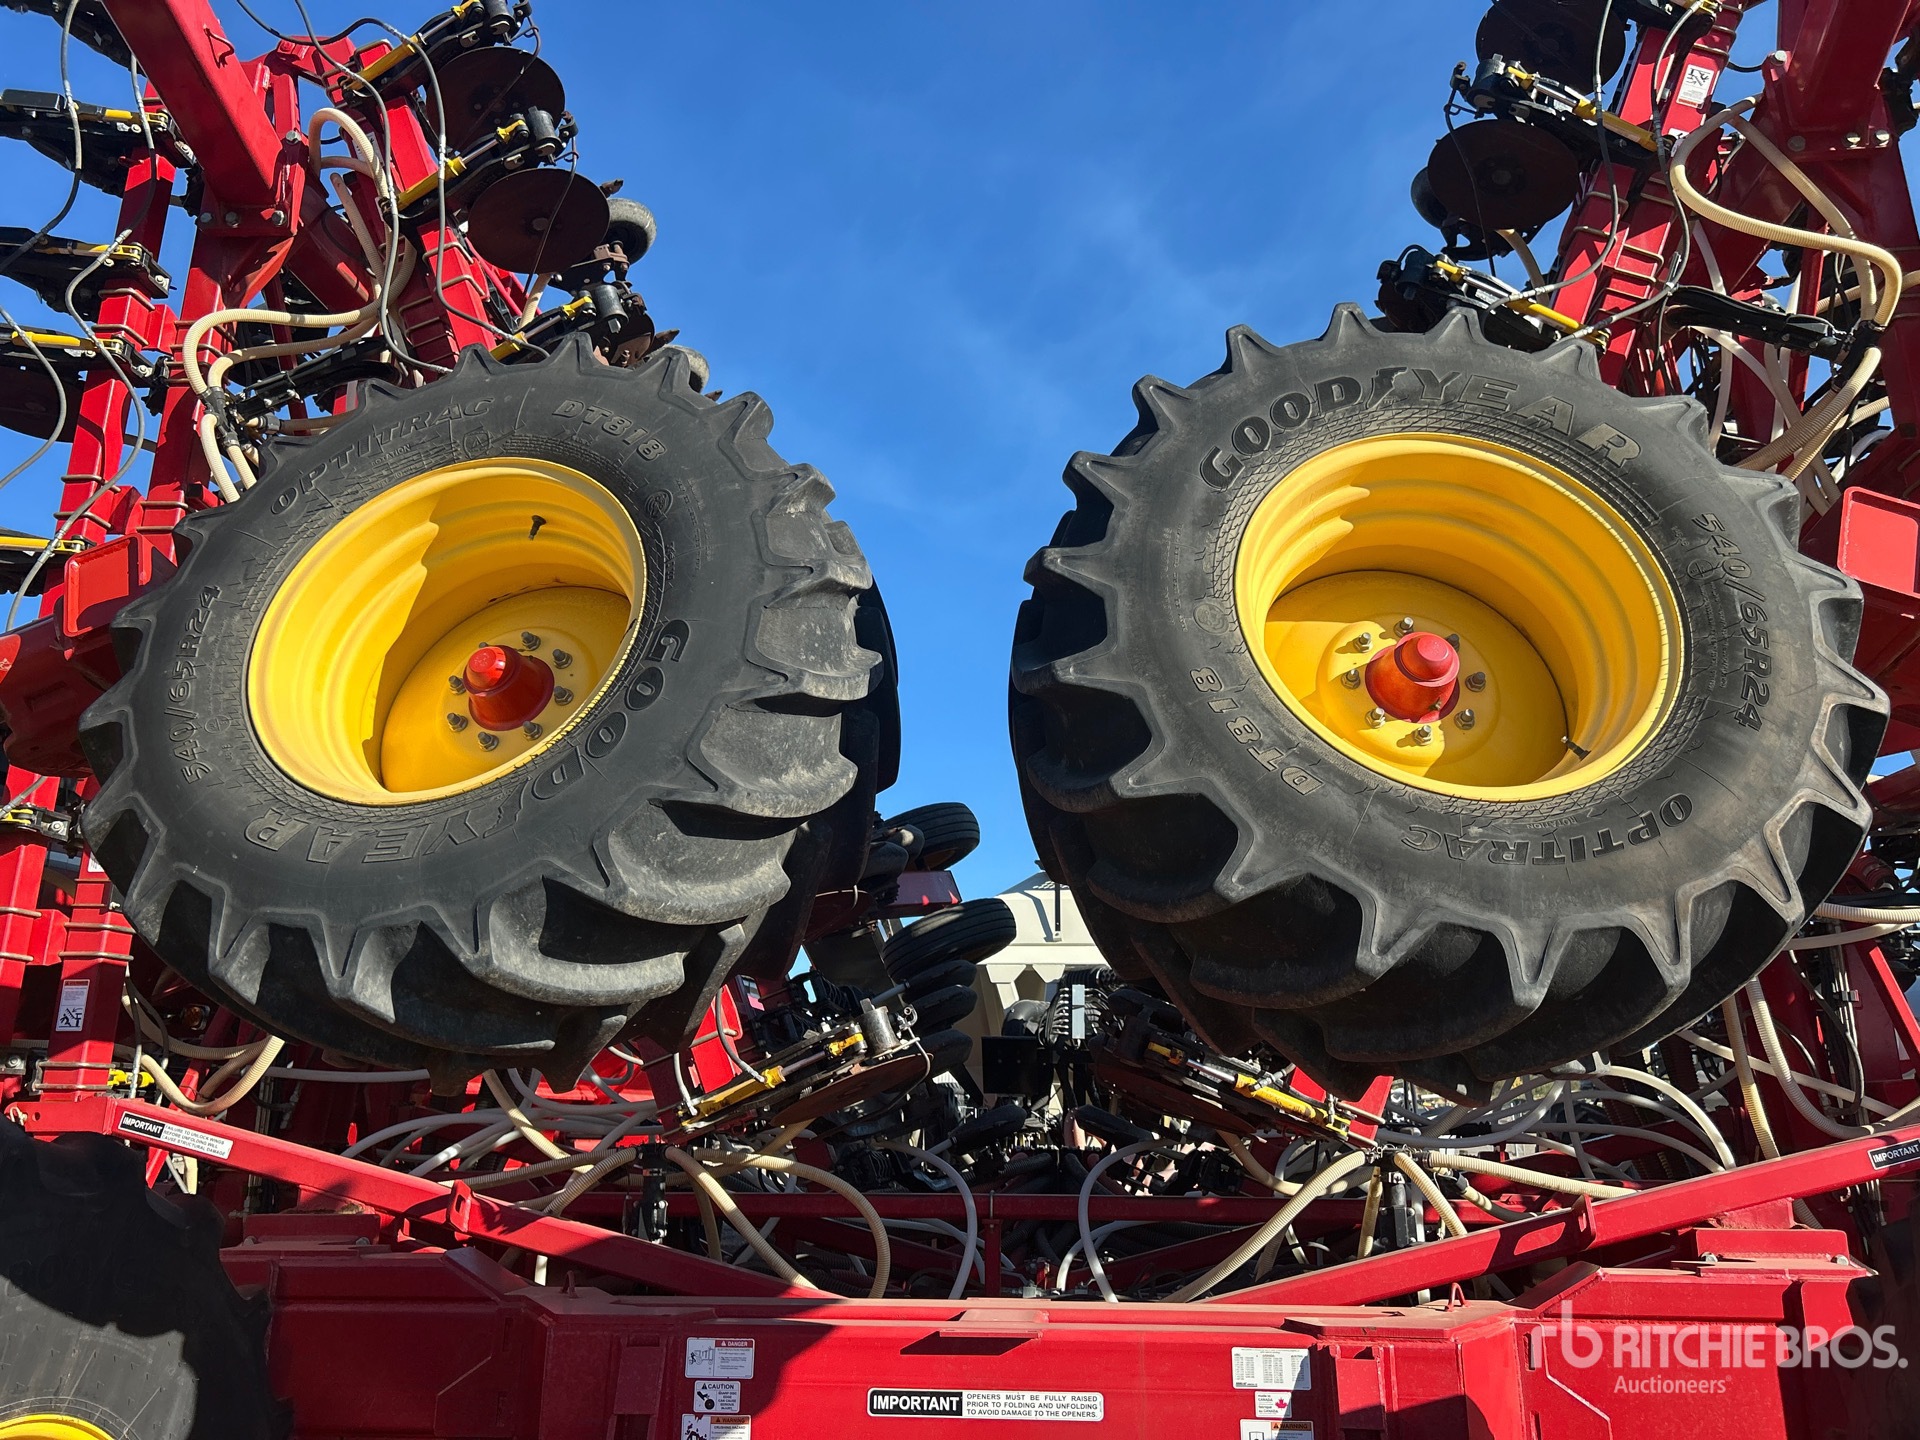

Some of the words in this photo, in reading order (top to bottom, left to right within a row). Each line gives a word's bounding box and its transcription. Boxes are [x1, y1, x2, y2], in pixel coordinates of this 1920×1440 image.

[271, 397, 495, 515] OPTITRAC
[552, 399, 667, 461] DT818
[1199, 366, 1642, 490] GOODYEAR
[1691, 513, 1772, 732] 540/65R24
[164, 585, 222, 785] 540/65R24
[244, 618, 691, 864] GOODYEAR
[1190, 667, 1324, 796] DT818
[1400, 793, 1694, 866] OPTITRAC
[122, 1116, 164, 1134] IMPORTANT
[1872, 1144, 1920, 1163] IMPORTANT
[872, 1394, 960, 1412] IMPORTANT
[966, 1393, 1001, 1401] OPENERS
[1044, 1394, 1067, 1402] FULLY
[966, 1408, 977, 1416] TO
[977, 1408, 1000, 1416] AVOID
[1001, 1409, 1033, 1417] DAMAGE
[1061, 1410, 1098, 1418] OPENERS.
[991, 1401, 1001, 1409] TO
